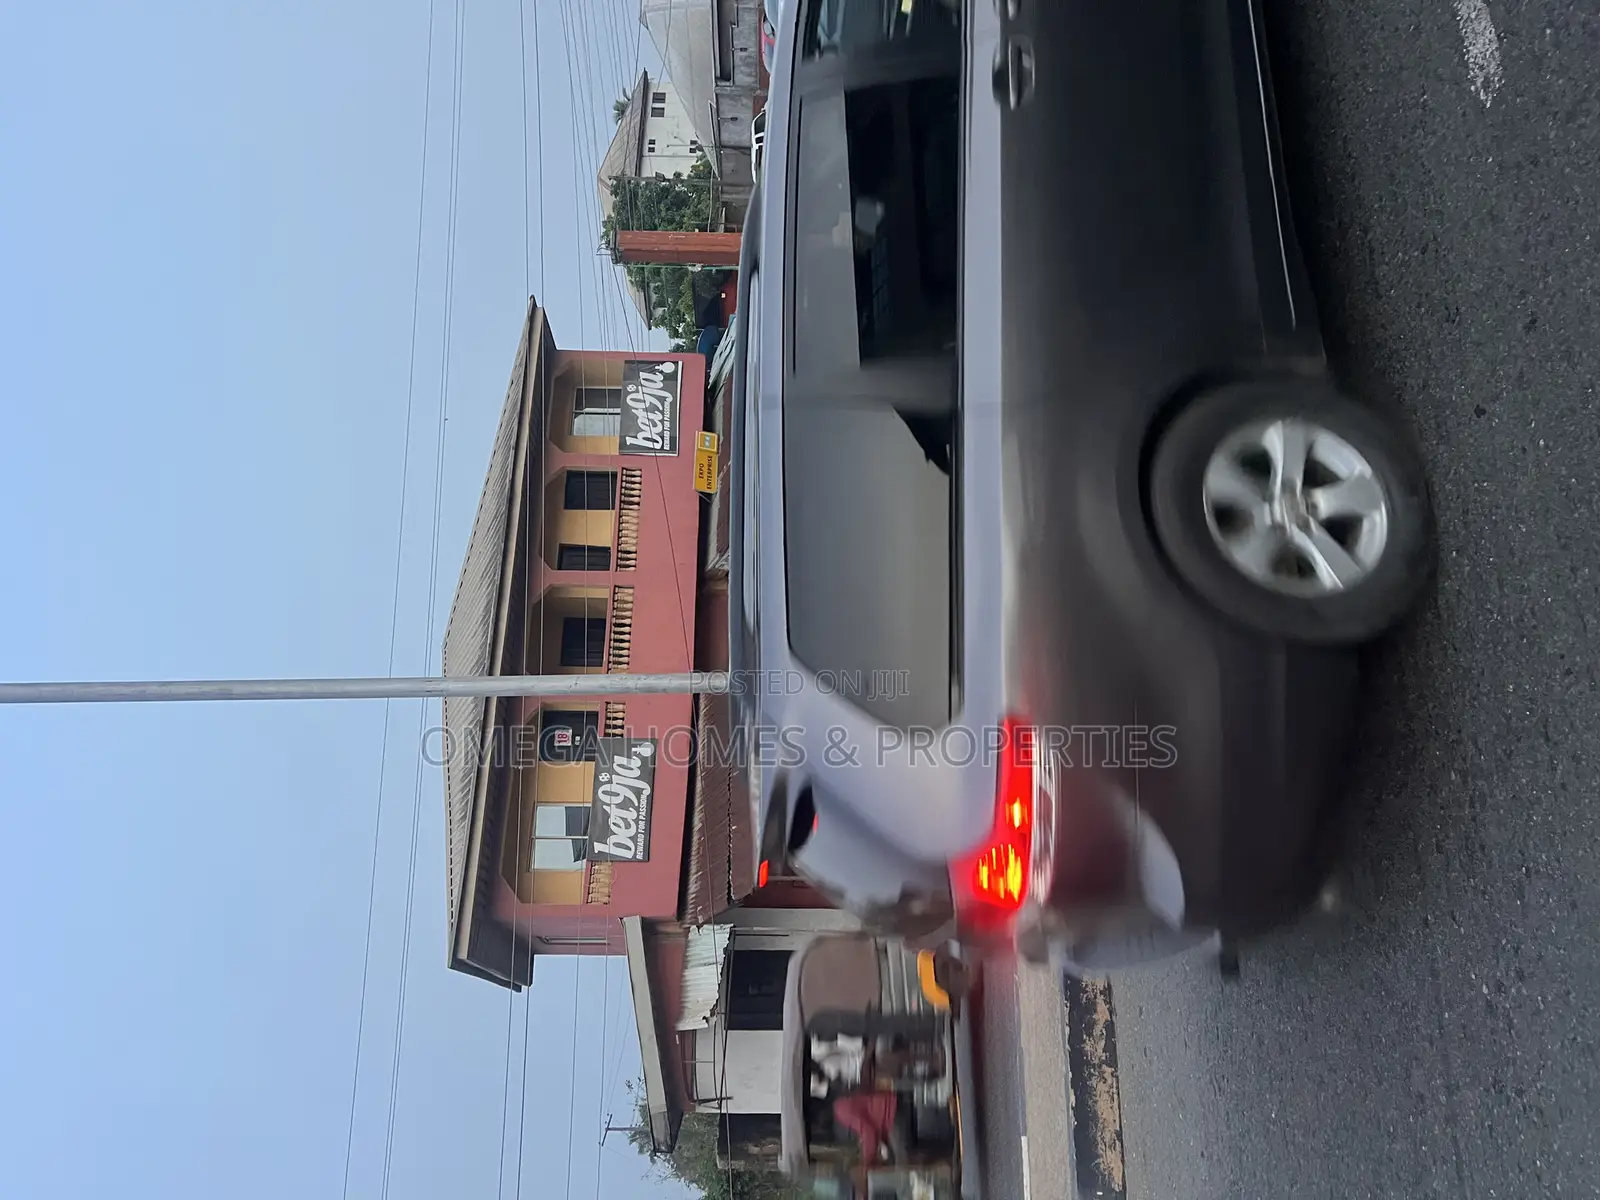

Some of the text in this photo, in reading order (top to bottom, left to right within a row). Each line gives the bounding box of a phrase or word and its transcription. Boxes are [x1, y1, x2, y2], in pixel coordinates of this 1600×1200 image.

[625, 371, 673, 450] bet9ja
[705, 455, 713, 490] ENTERPRISE
[593, 756, 651, 859] bet9ja
[636, 794, 647, 859] REWARD FOR PASSION
